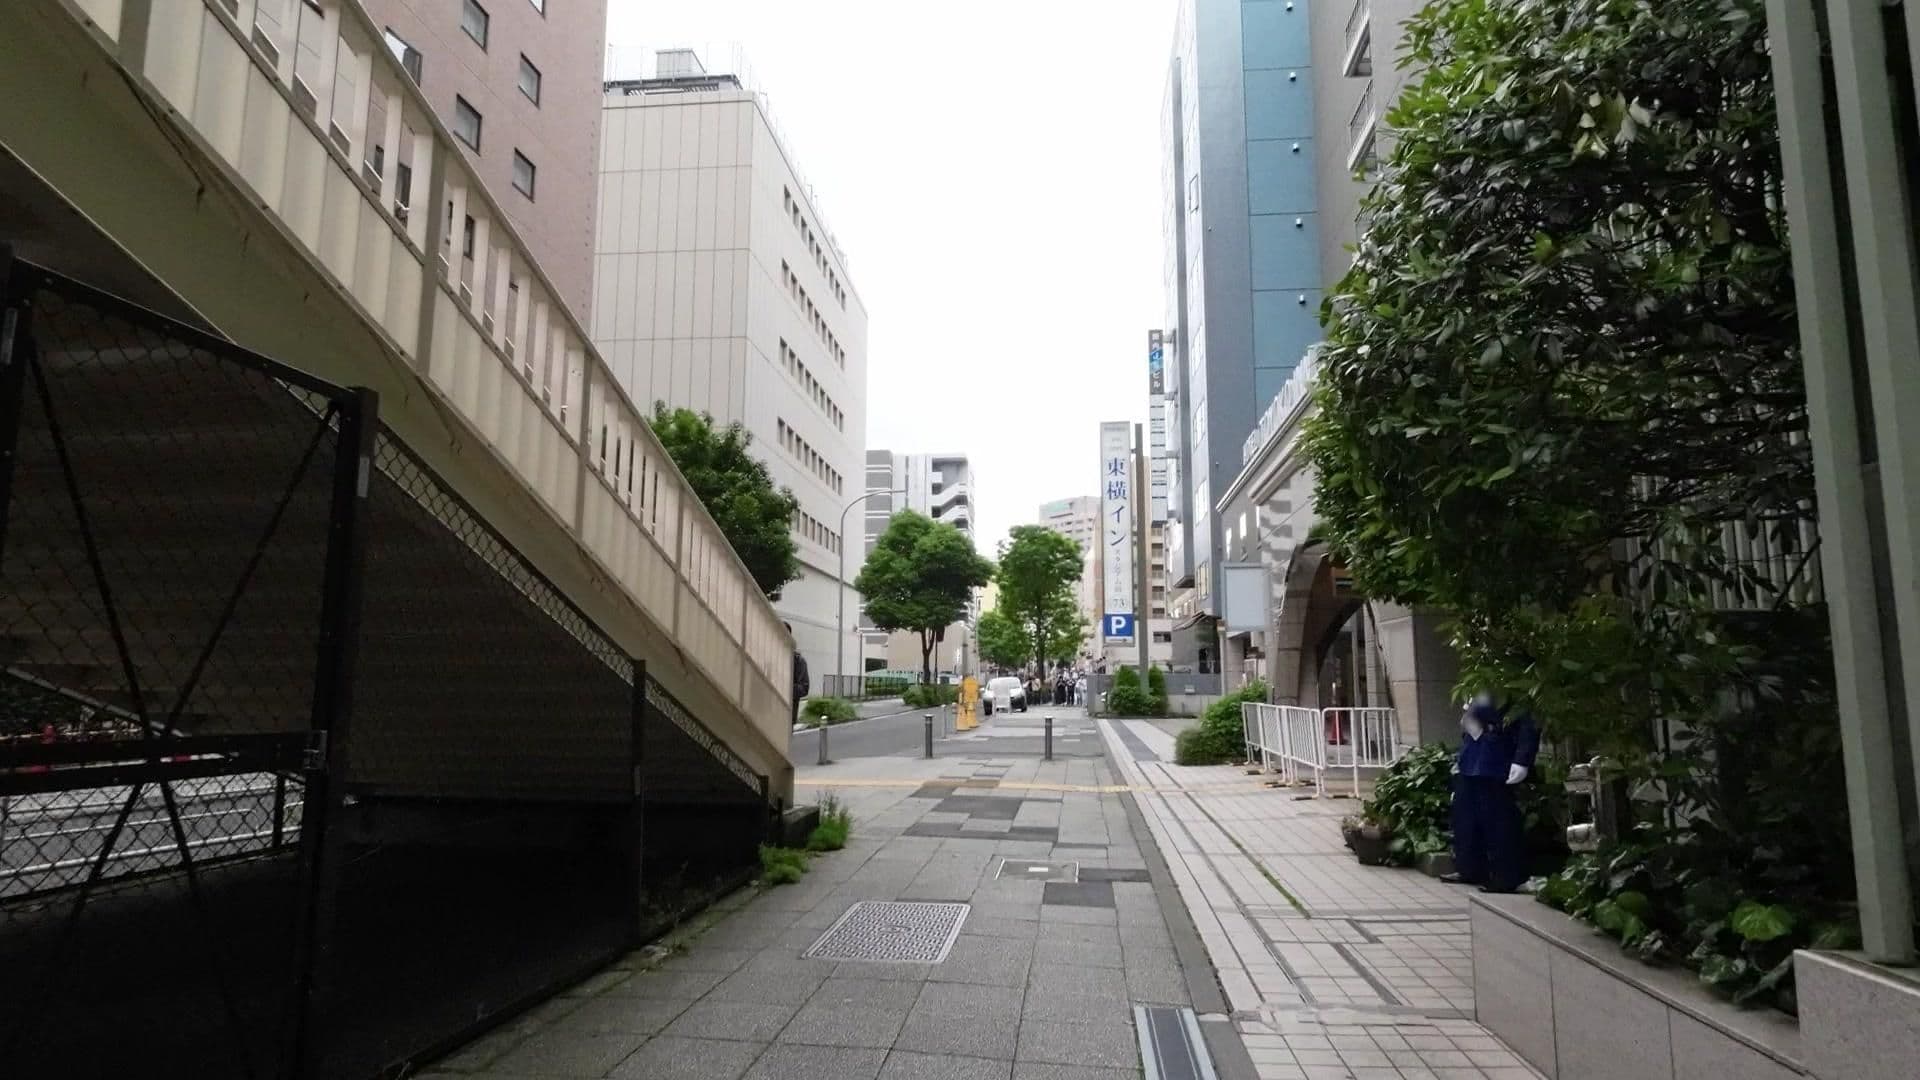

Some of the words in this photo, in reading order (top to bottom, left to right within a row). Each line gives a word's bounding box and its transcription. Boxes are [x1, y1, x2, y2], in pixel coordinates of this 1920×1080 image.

[1107, 457, 1127, 546] 東横イン
[1111, 616, 1127, 635] P
